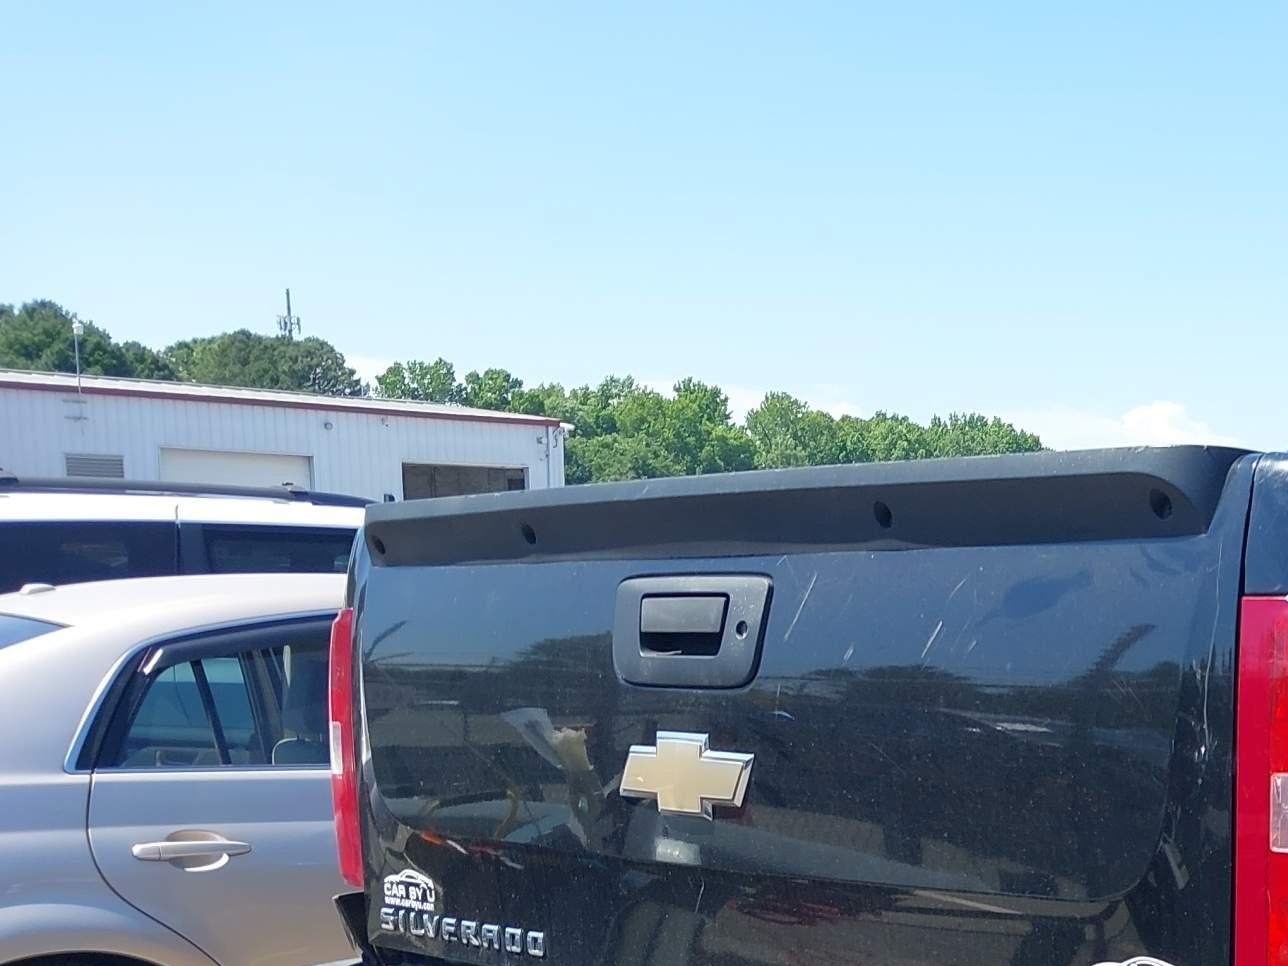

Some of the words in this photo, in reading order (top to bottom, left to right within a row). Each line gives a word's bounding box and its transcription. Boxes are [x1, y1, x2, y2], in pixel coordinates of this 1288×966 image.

[384, 882, 406, 898] CAR
[409, 885, 422, 900] BY
[427, 889, 435, 902] U
[384, 895, 435, 911] www.carbyu.com
[380, 907, 545, 957] SILVERADO
